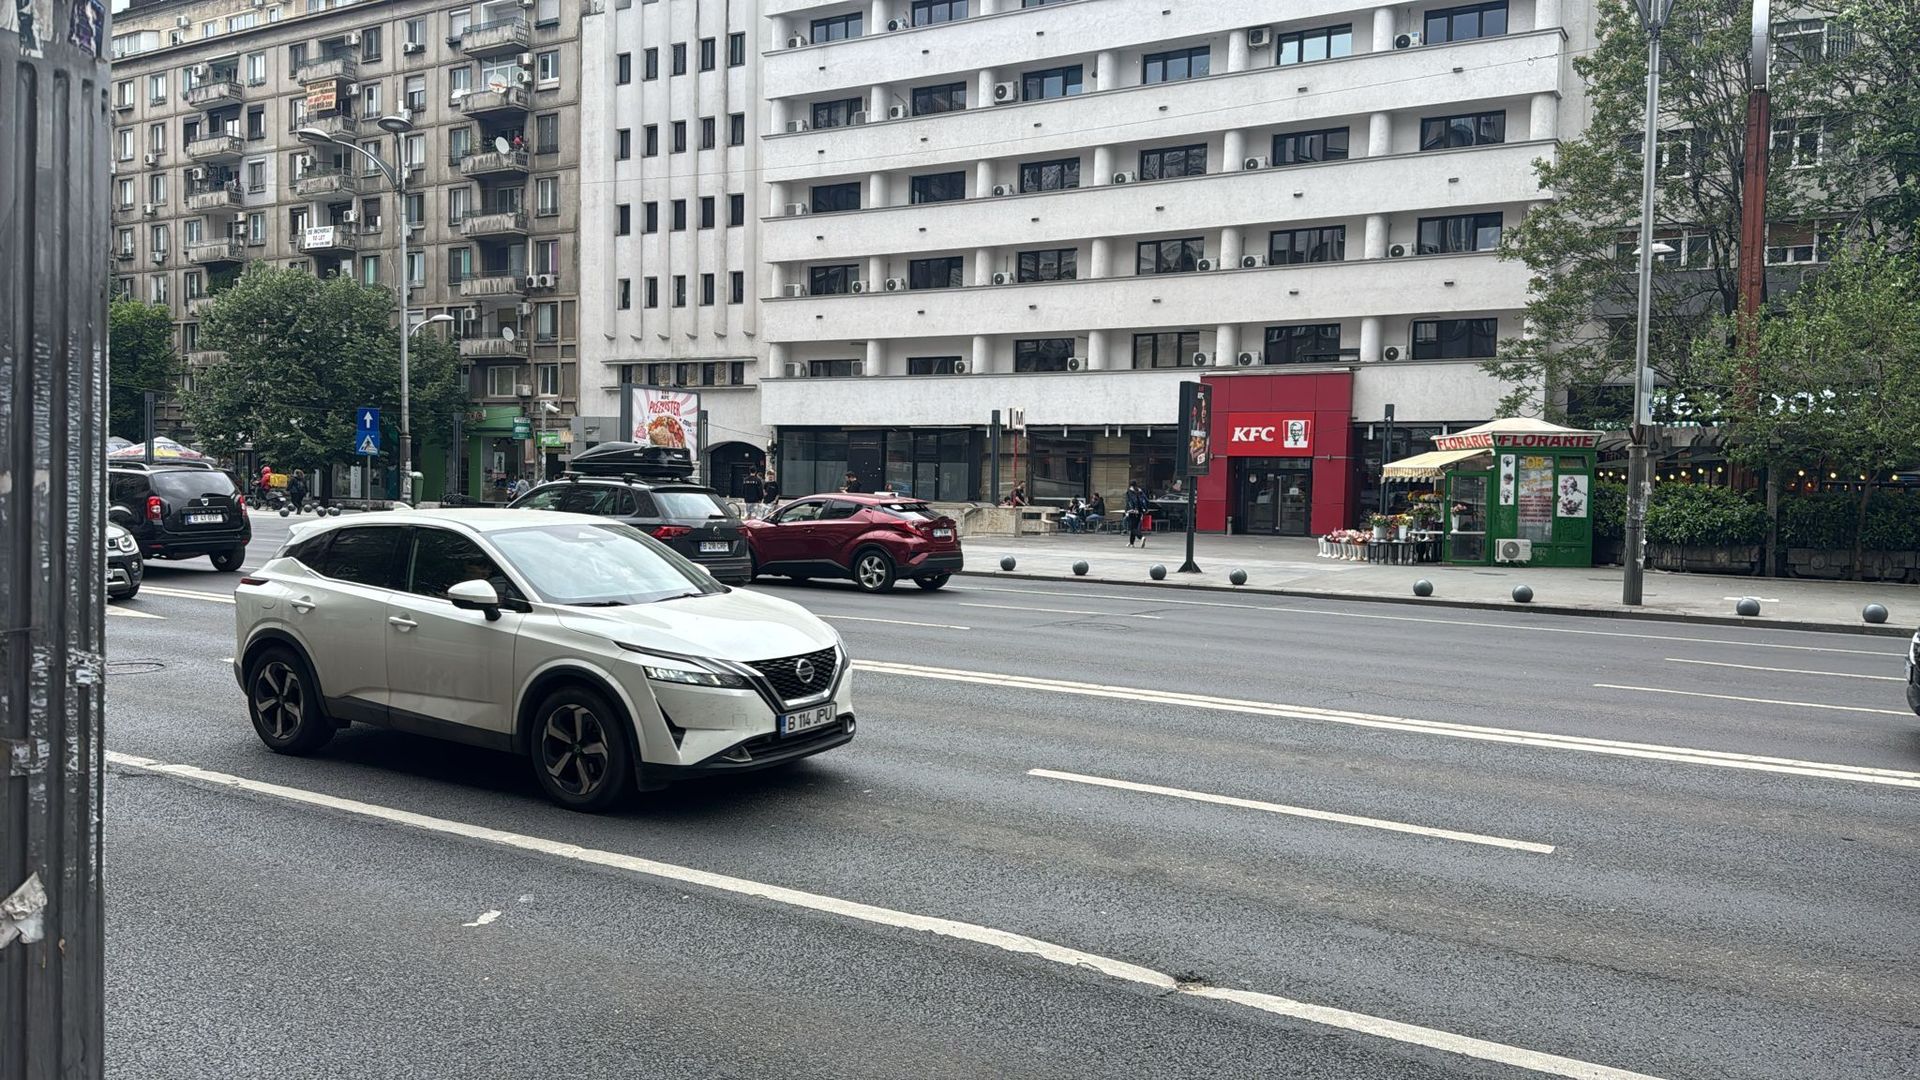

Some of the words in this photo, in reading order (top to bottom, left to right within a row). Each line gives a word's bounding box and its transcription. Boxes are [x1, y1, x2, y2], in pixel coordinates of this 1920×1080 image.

[1015, 410, 1024, 426] M
[1232, 426, 1276, 442] KFC
[1500, 435, 1595, 448] FLORARIE
[1437, 435, 1493, 450] FLORARIE
[788, 716, 796, 730] B
[799, 711, 811, 728] 114
[814, 707, 832, 724] JPU
